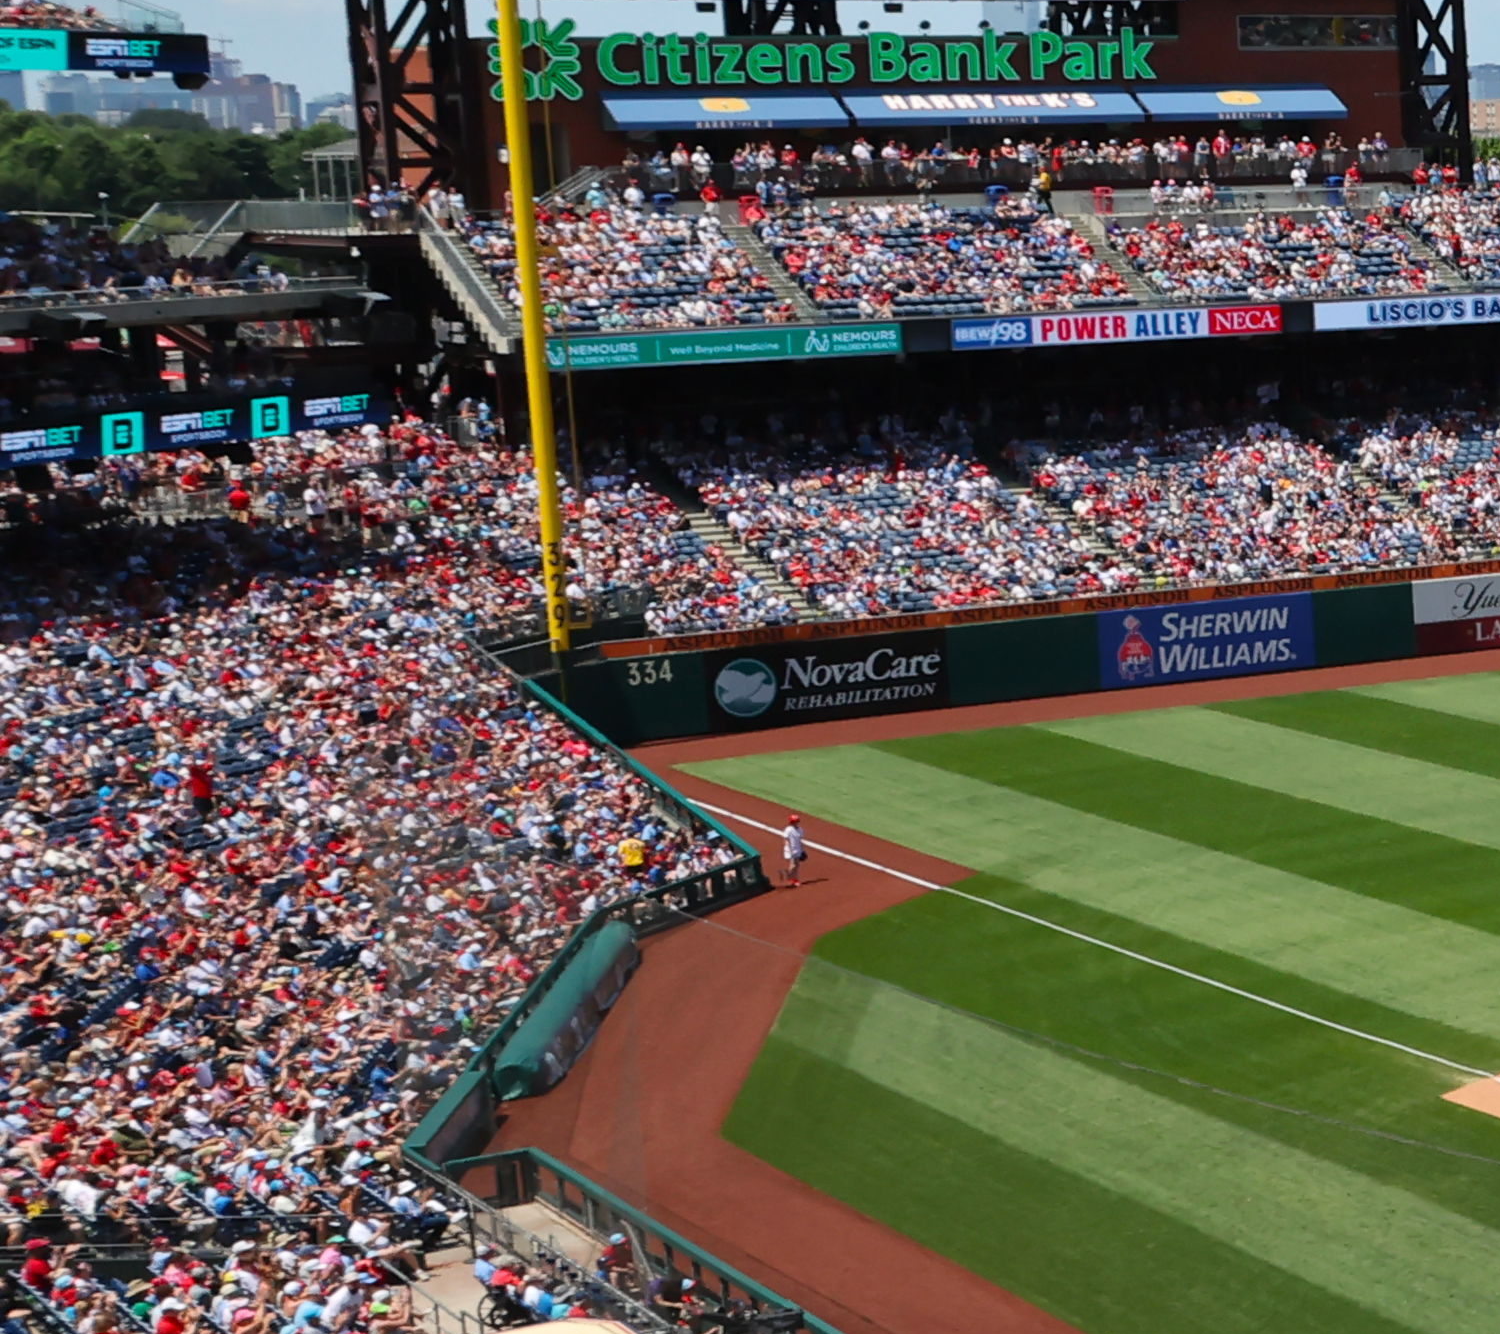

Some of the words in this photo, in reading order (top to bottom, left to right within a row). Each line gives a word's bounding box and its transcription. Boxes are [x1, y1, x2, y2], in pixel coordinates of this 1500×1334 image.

[597, 30, 854, 87] Citizens
[868, 27, 1021, 83] Bank
[1029, 26, 1157, 82] Park
[881, 92, 997, 111] HARRY
[1000, 95, 1041, 109] THE
[1041, 92, 1098, 110] K'S
[832, 329, 898, 343] NEMOURS
[1040, 315, 1128, 343] POWER
[1134, 312, 1202, 338] ALLEY
[1213, 309, 1280, 332] NECA
[1083, 589, 1191, 613] ASPLUNDH
[1158, 605, 1290, 643] SHERWIN
[627, 658, 674, 687] 334
[780, 646, 942, 691] NovaCare
[783, 682, 937, 713] REHABILITATION
